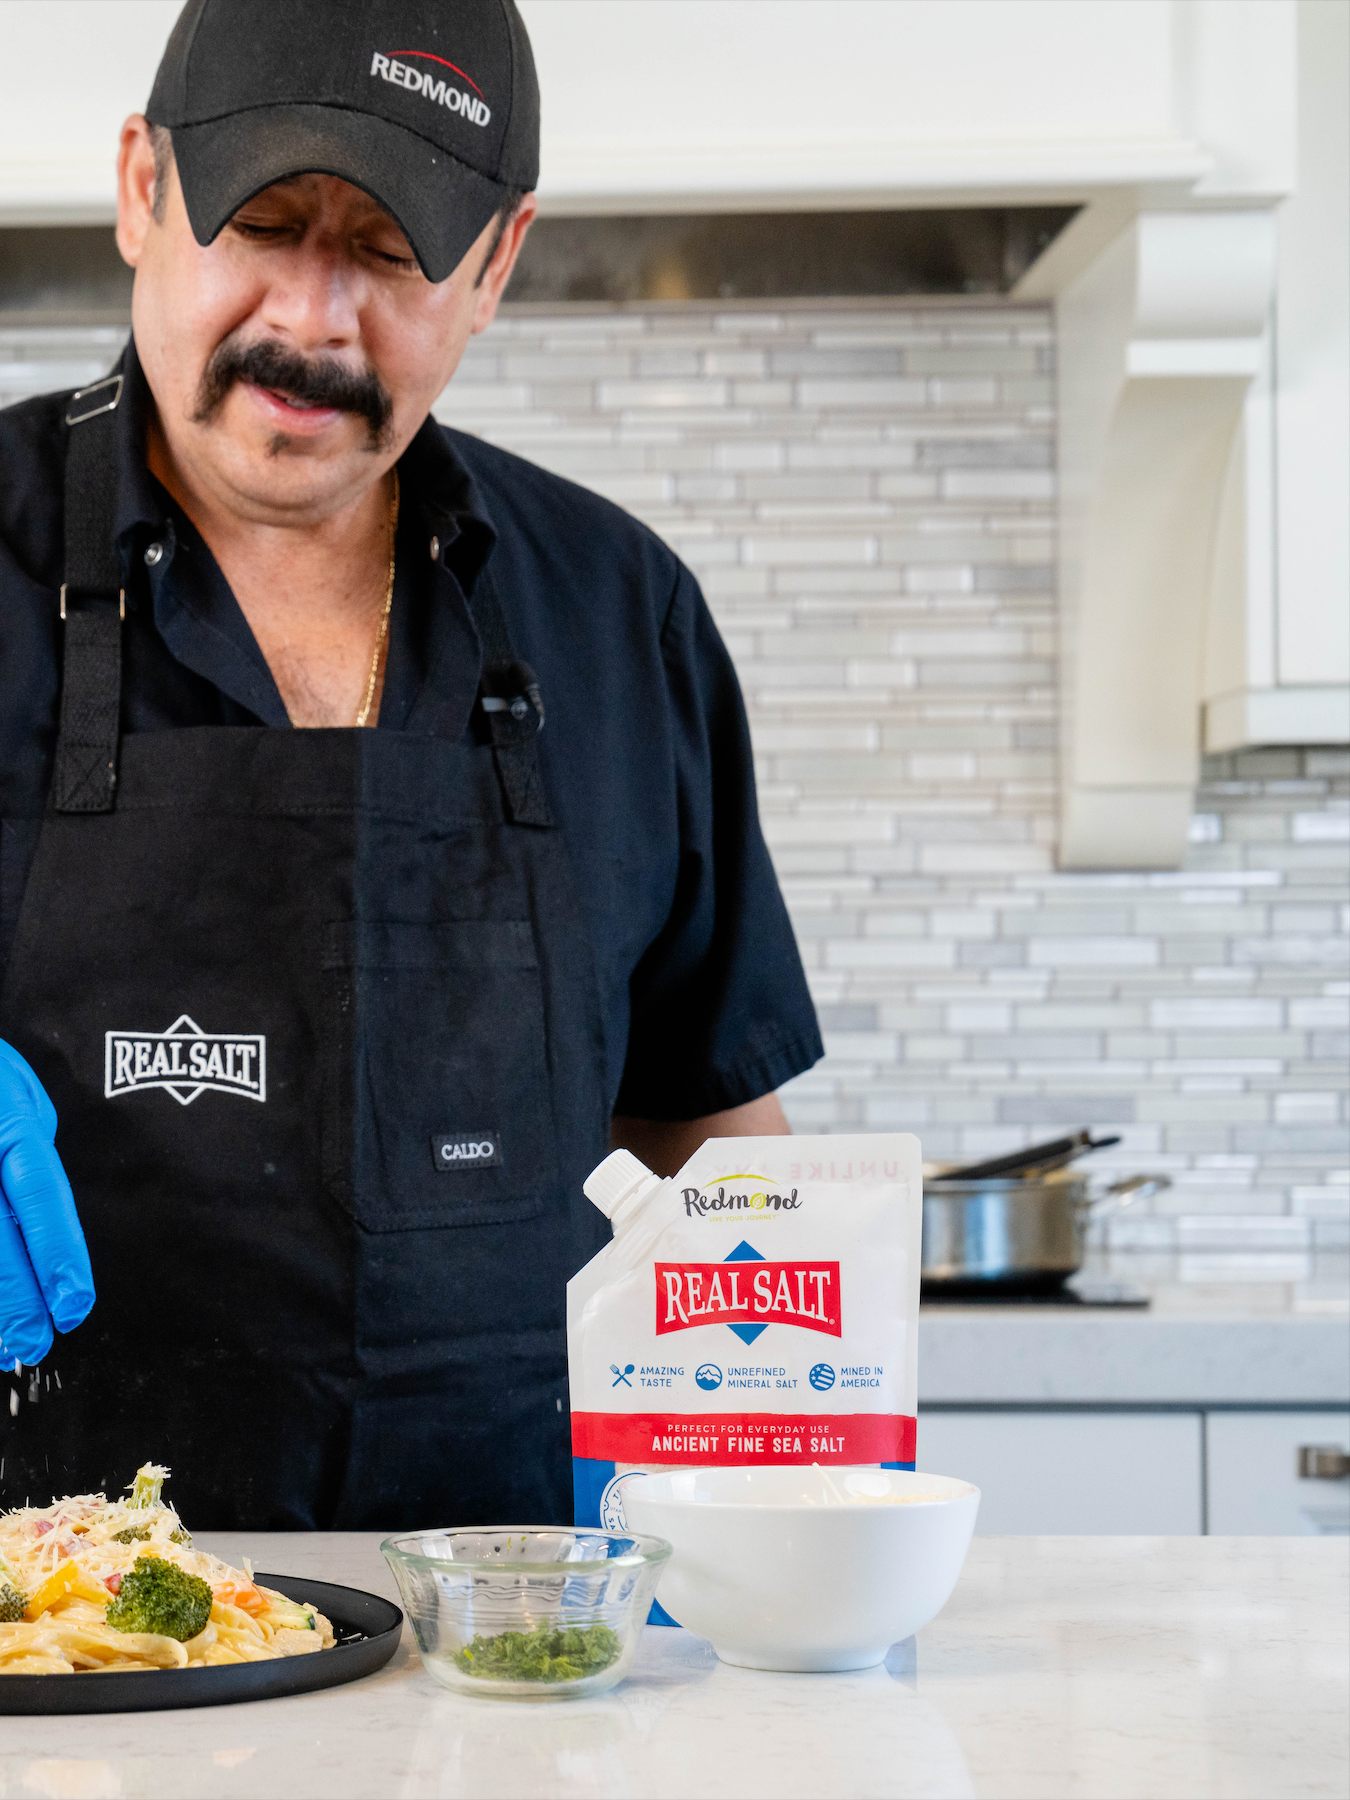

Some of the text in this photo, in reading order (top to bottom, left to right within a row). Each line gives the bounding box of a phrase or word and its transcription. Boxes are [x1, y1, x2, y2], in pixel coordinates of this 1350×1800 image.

[370, 51, 491, 127] REDMOND
[113, 1040, 188, 1085] REAL
[441, 1141, 494, 1160] CALDO
[681, 1187, 803, 1217] Redmond
[662, 1271, 749, 1324] REAL
[640, 1367, 684, 1375] AMAZING
[727, 1367, 786, 1376] UNREFINED
[841, 1367, 883, 1375] MINED IN
[640, 1378, 672, 1387] TASTE
[727, 1379, 798, 1388] MINERAL SALT
[841, 1379, 880, 1387] AMERICA
[667, 1424, 830, 1434] PERFECT FOR EVERYDAY USE
[652, 1436, 845, 1453] ANCIENT FINE SEA SALT
